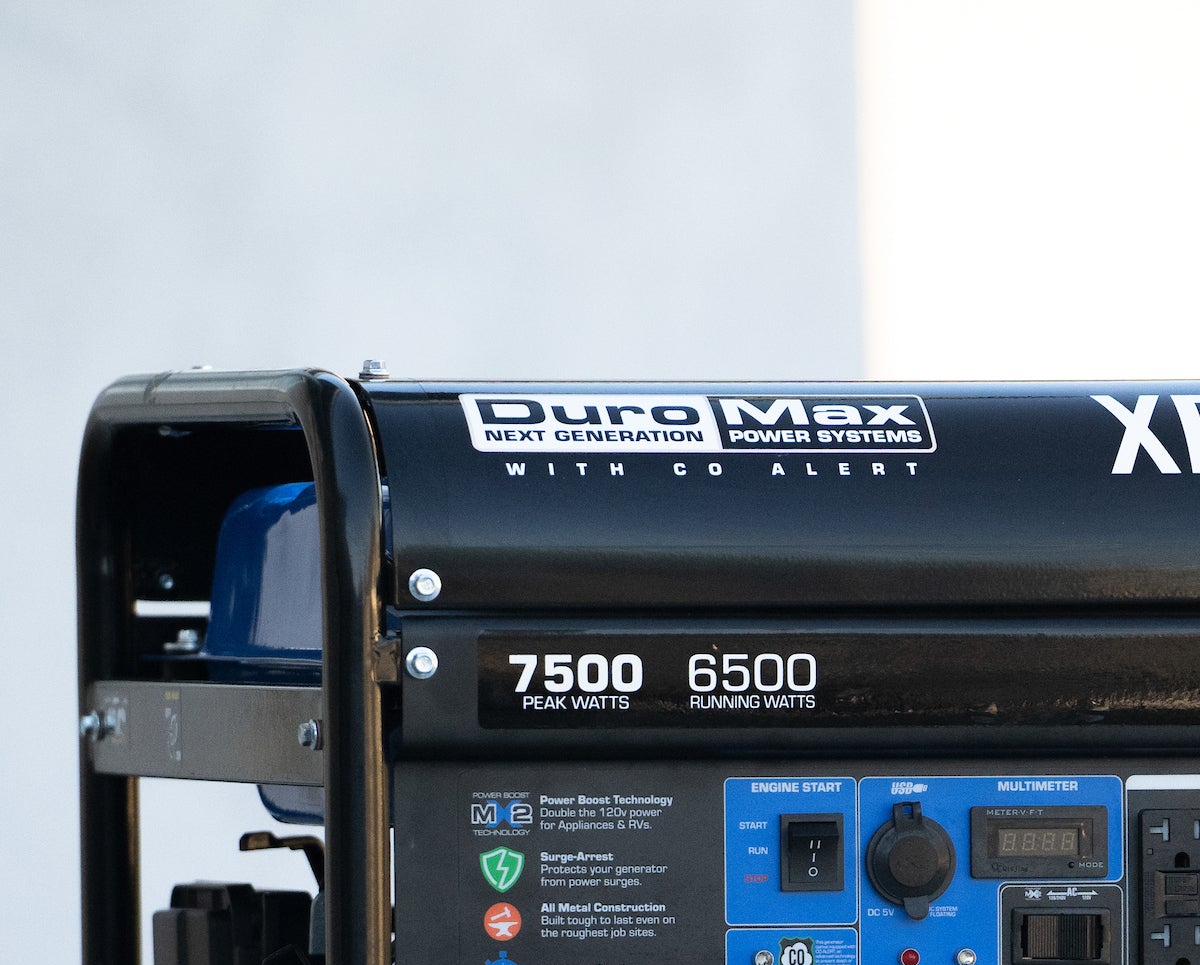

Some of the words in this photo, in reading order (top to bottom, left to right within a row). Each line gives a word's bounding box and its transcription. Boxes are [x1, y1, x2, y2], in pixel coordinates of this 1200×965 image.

[486, 430, 545, 442] NEXT
[555, 430, 703, 442] GENERATION
[729, 430, 810, 443] POWER
[818, 430, 922, 443] SYSTEMS
[505, 462, 624, 476] WITH
[673, 462, 722, 476] CO
[771, 461, 919, 476] ALERT
[508, 654, 643, 693] 7500
[688, 653, 817, 693] 6500
[522, 696, 567, 710] PEAK
[570, 695, 630, 709] WATTS
[690, 695, 761, 709] RUNNING
[762, 694, 816, 709] WATTS
[751, 782, 799, 793] ENGINE
[802, 782, 842, 792] START
[891, 782, 913, 795] USB
[997, 781, 1078, 791] MULTIMETER
[540, 795, 576, 805] Power
[578, 795, 611, 805] Boost
[613, 795, 673, 807] Technology
[540, 808, 576, 817] Double
[578, 808, 596, 817] the
[599, 808, 627, 817] 120v
[629, 809, 662, 819] power
[540, 820, 556, 829] for
[558, 820, 614, 832] Appliances
[617, 821, 625, 829] &
[628, 820, 652, 830] RVs.
[739, 822, 768, 830] START
[540, 852, 614, 864] Surge-Arrest
[540, 865, 587, 874] Protects
[590, 866, 613, 876] your
[615, 865, 668, 876] generator
[540, 877, 566, 886] from
[569, 878, 601, 888] power
[604, 878, 642, 888] surges.
[744, 874, 768, 883] STOP
[1067, 888, 1078, 896] AC
[541, 903, 556, 912] All
[558, 903, 591, 912] Metal
[594, 903, 666, 912] Construction
[867, 908, 880, 916] DC
[882, 908, 894, 916] 5V
[541, 915, 565, 925] Built
[567, 915, 597, 927] tough
[600, 917, 611, 925] to
[613, 915, 633, 925] last
[636, 917, 660, 925] even
[541, 928, 559, 937] the
[561, 928, 609, 939] roughest
[610, 928, 626, 939] job
[629, 928, 656, 937] sites.
[789, 949, 805, 965] CO
